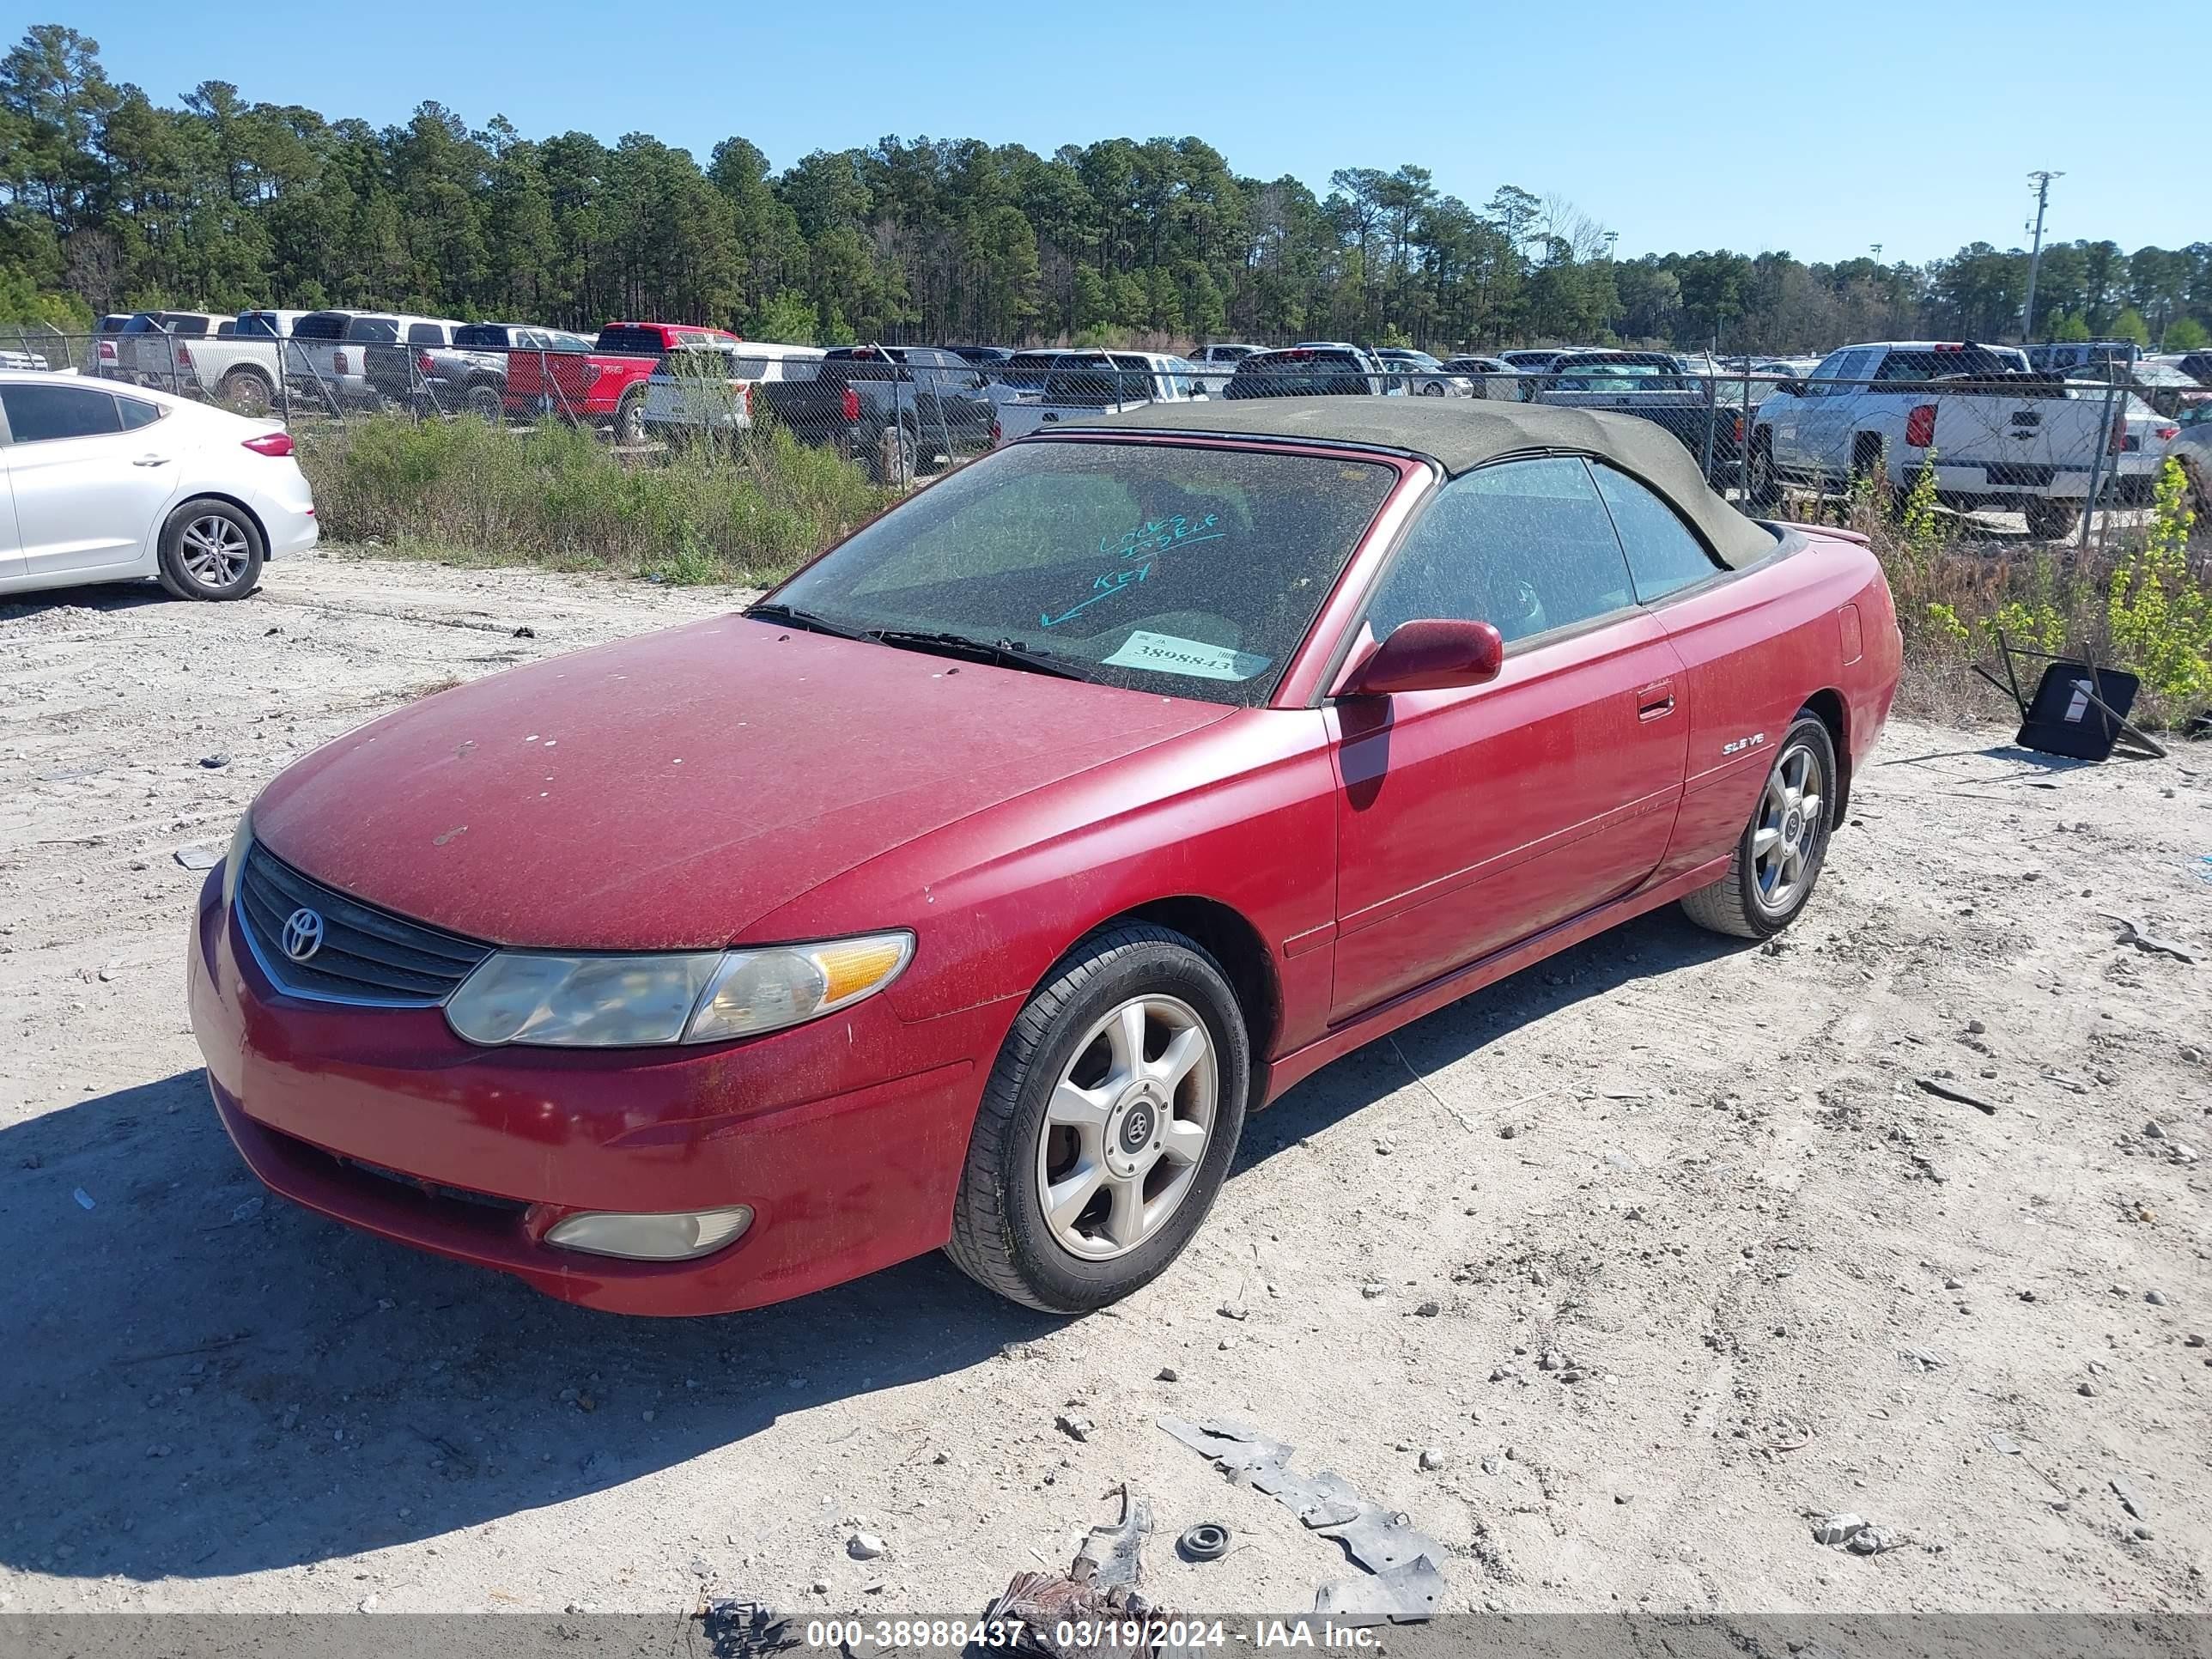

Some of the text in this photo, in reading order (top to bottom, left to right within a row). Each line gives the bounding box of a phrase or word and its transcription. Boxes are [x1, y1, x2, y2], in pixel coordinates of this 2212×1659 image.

[1100, 514, 1187, 553] LOCKS
[1092, 562, 1152, 589] KEY
[1723, 732, 1765, 756] SLE V6
